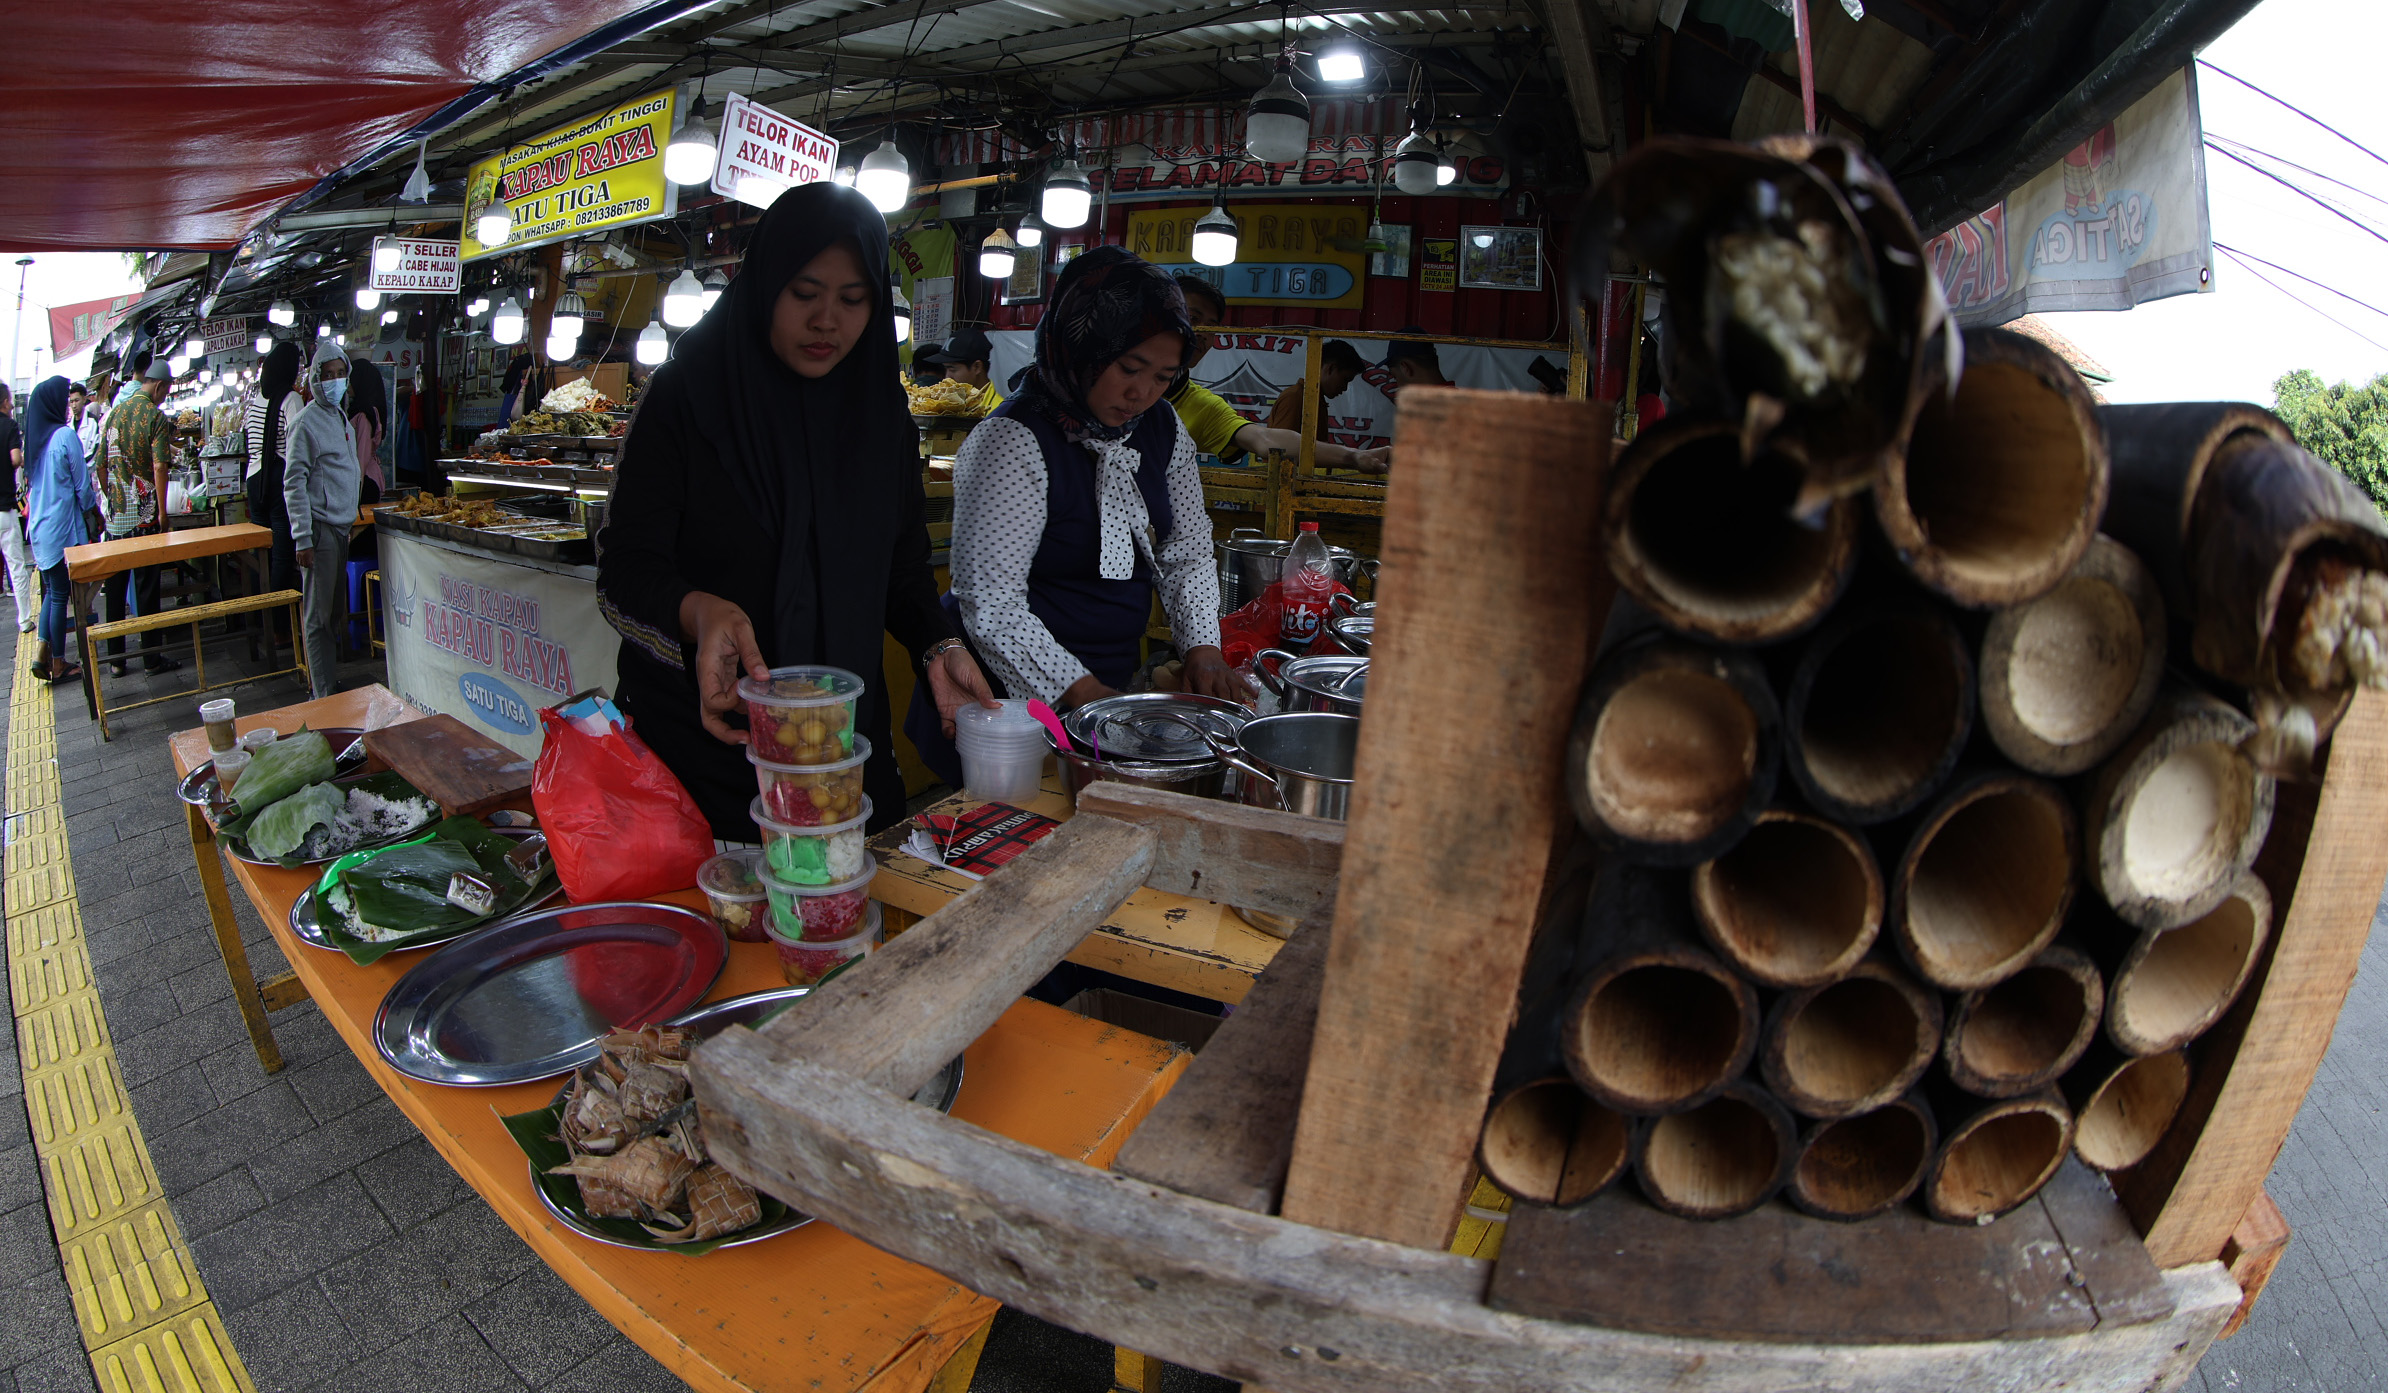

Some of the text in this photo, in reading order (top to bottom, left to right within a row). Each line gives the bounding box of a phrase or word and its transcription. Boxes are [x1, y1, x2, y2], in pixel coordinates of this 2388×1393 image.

[499, 145, 544, 169] MASAKAN
[620, 97, 668, 124] TINGGI
[575, 123, 657, 180] RAYA
[737, 107, 830, 164] TELOR IKAN
[1306, 134, 1399, 154] RAY
[736, 140, 786, 174] AYAM
[788, 159, 819, 183] POP
[1087, 160, 1298, 194] SELAMAT
[509, 179, 611, 227] ATU TIGA
[524, 219, 567, 239] WHATSAPP
[575, 197, 650, 226] 082133867789
[405, 260, 429, 272] CABE
[431, 261, 456, 273] HIJAU
[414, 245, 457, 258] SELLER
[377, 275, 454, 288] KEPALO KAKAP
[1248, 268, 1327, 294] TIGA
[201, 317, 245, 337] TELOR IKAN
[225, 333, 246, 349] KAKAP
[1212, 334, 1303, 354] UKIT
[440, 575, 540, 634] NASI KAPAU
[423, 601, 576, 698] KAPAU RAYA
[463, 680, 529, 727] SATU TIGA
